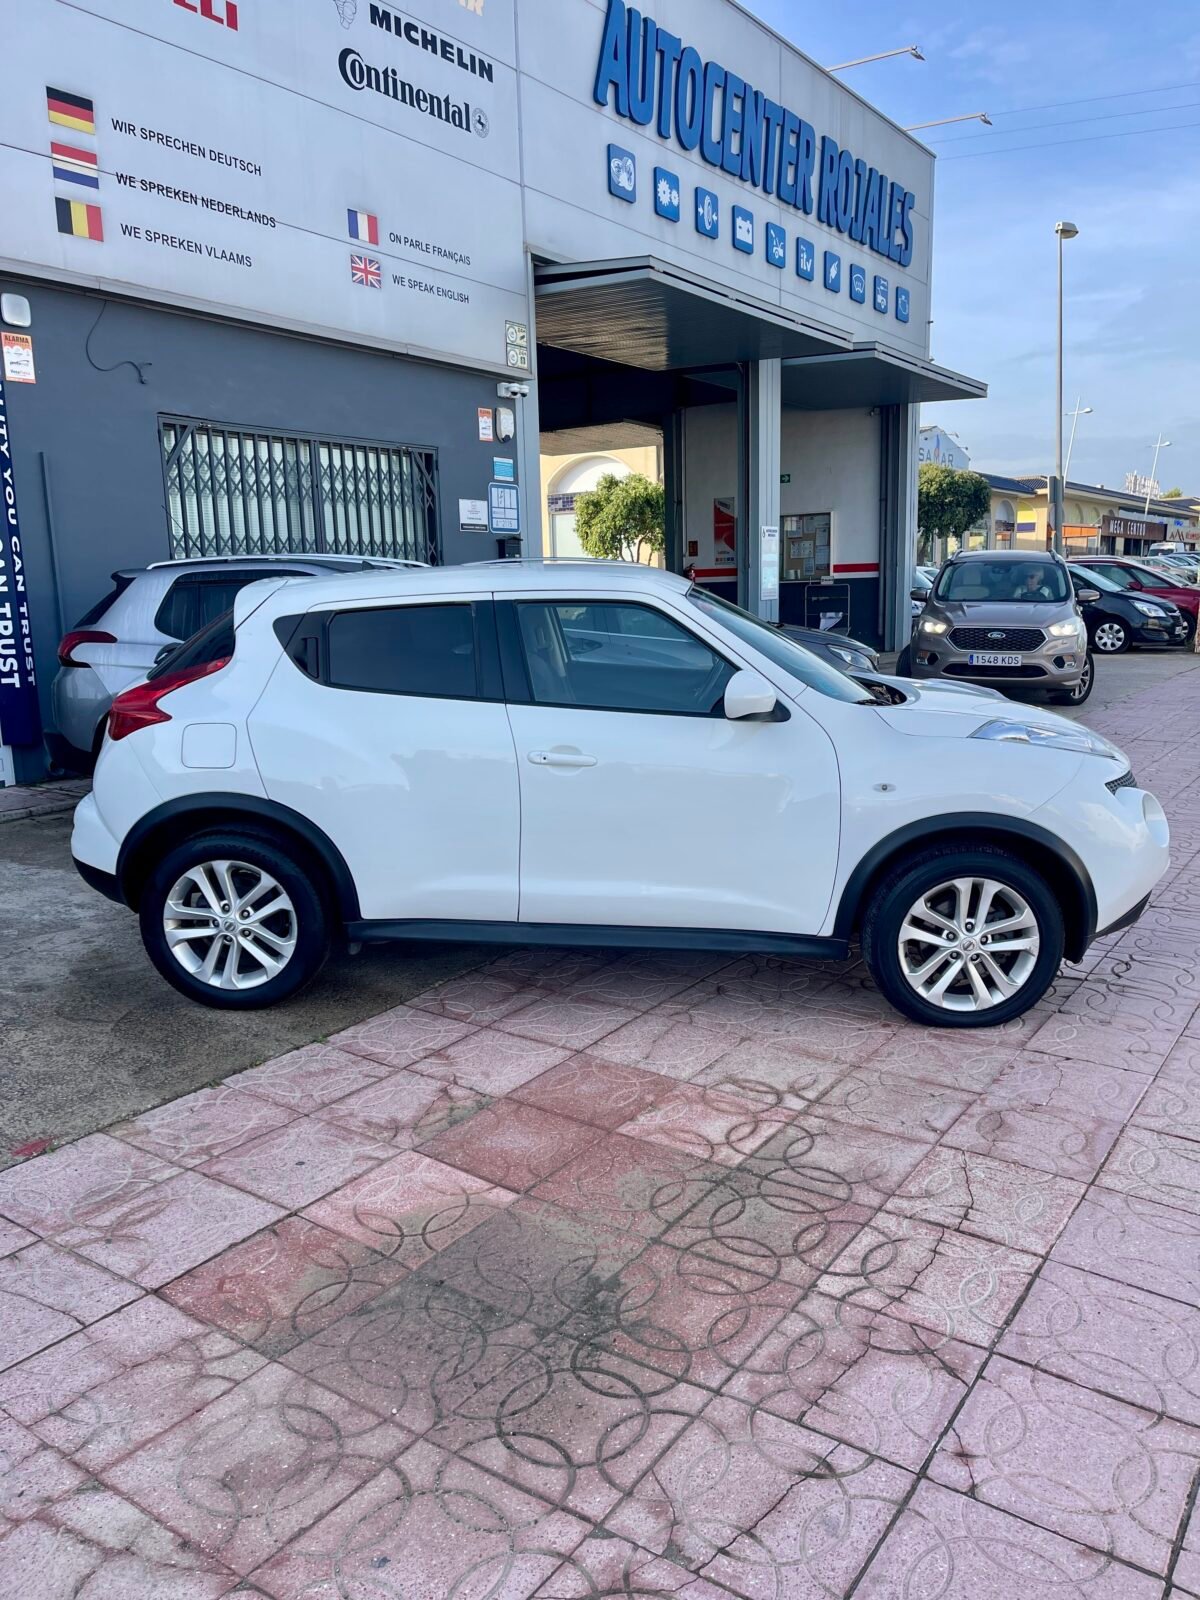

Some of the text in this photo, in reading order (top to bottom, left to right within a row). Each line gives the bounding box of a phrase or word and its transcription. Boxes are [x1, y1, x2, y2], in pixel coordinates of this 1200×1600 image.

[369, 3, 494, 83] MICHELIN
[338, 47, 472, 133] Continental
[111, 118, 262, 177] WIR SPRECHEN DEUTSCH
[593, 0, 915, 267] AUTOCENTER ROJALES
[115, 171, 276, 229] WE SPREKEN NEDERLANDS
[120, 223, 252, 268] WE SPREKEN VLAAMS
[389, 232, 471, 266] ON PARLE FRANÇAIS
[392, 274, 470, 304] WE SPEAK ENGLISH
[4, 334, 29, 344] ALARMA
[3, 467, 17, 525] YOU
[11, 535, 25, 592] CAN
[19, 601, 36, 687] TRUST
[976, 655, 1020, 665] 1548 KDS
